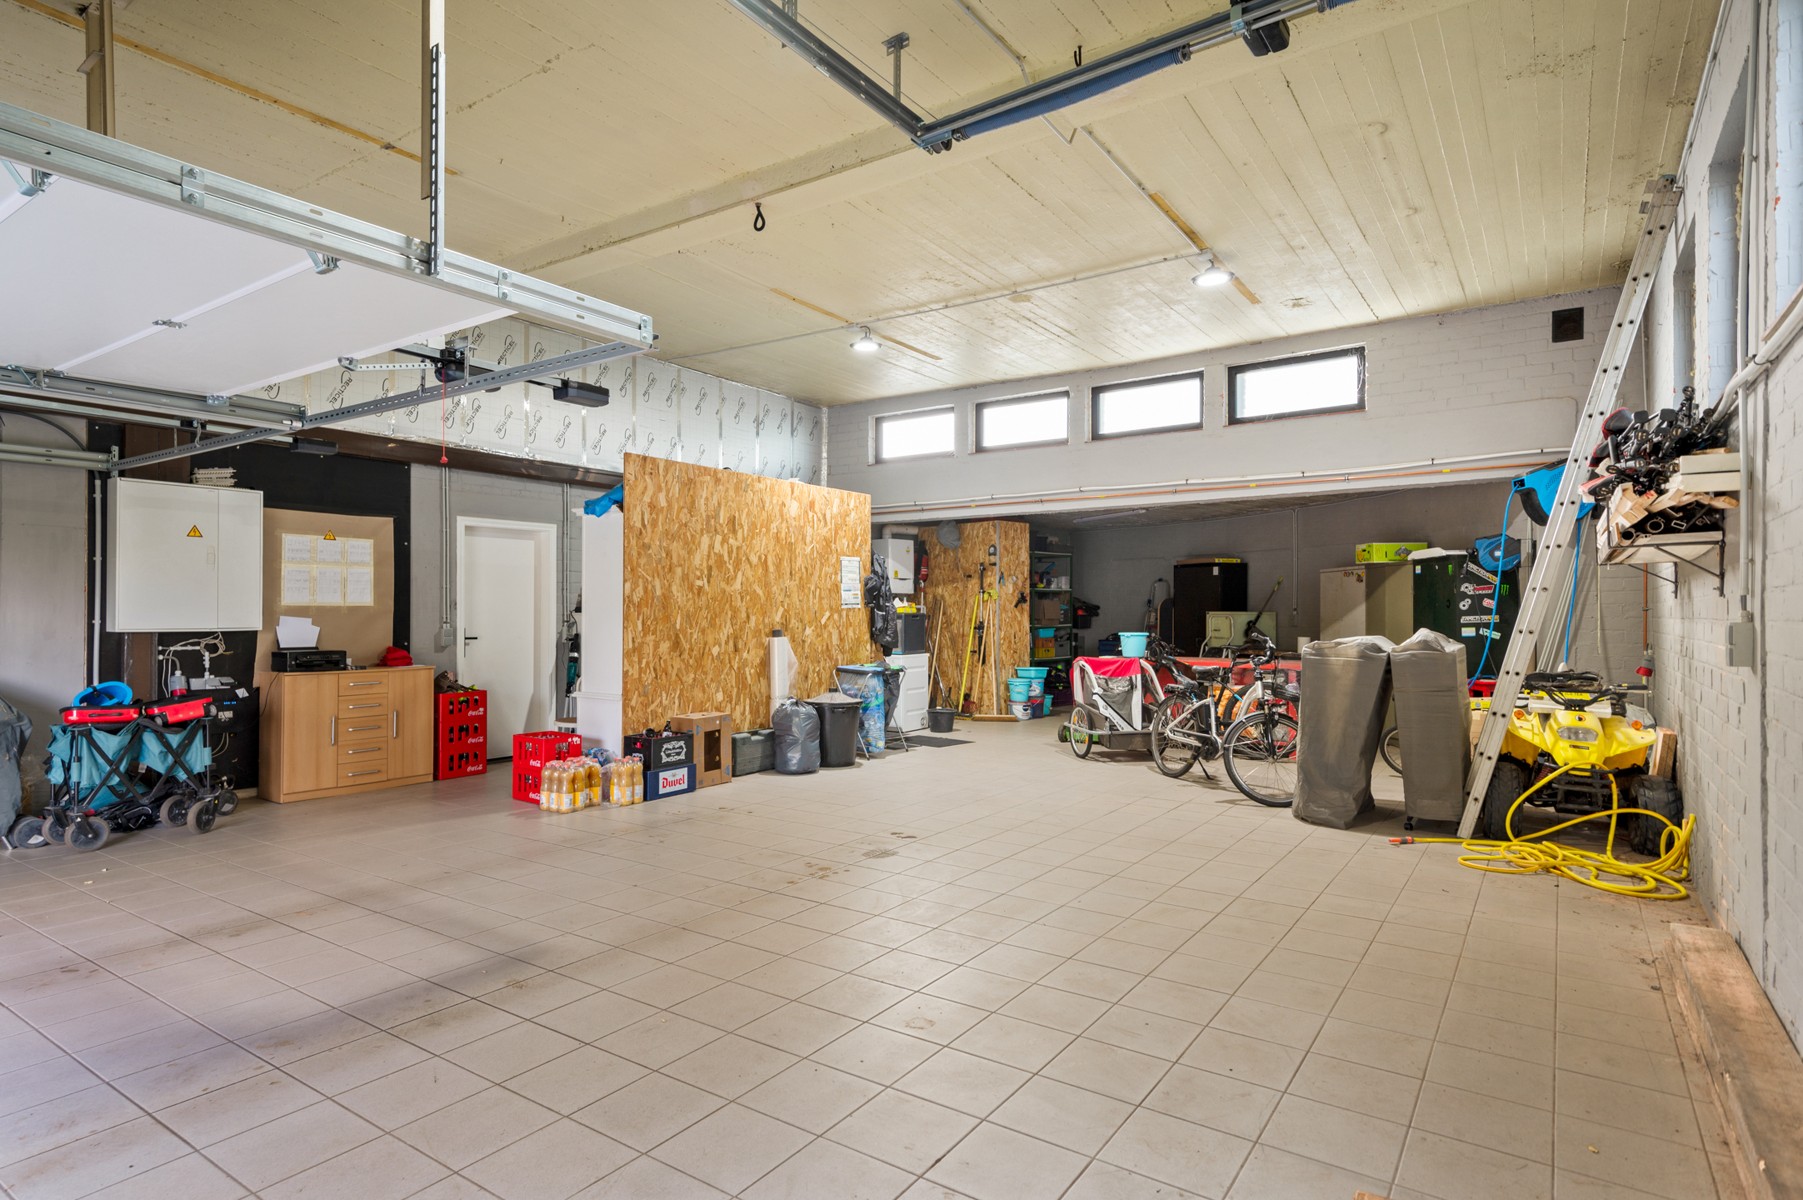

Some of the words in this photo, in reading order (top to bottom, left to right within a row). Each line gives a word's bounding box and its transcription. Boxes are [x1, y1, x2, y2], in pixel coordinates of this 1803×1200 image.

[328, 377, 353, 404] RECTICEL
[642, 376, 656, 397] RECTICEL
[496, 410, 514, 434] RECTICEL
[555, 421, 572, 444] RECTICEL
[592, 428, 607, 450] RECTICEL
[662, 774, 685, 788] Duvel
